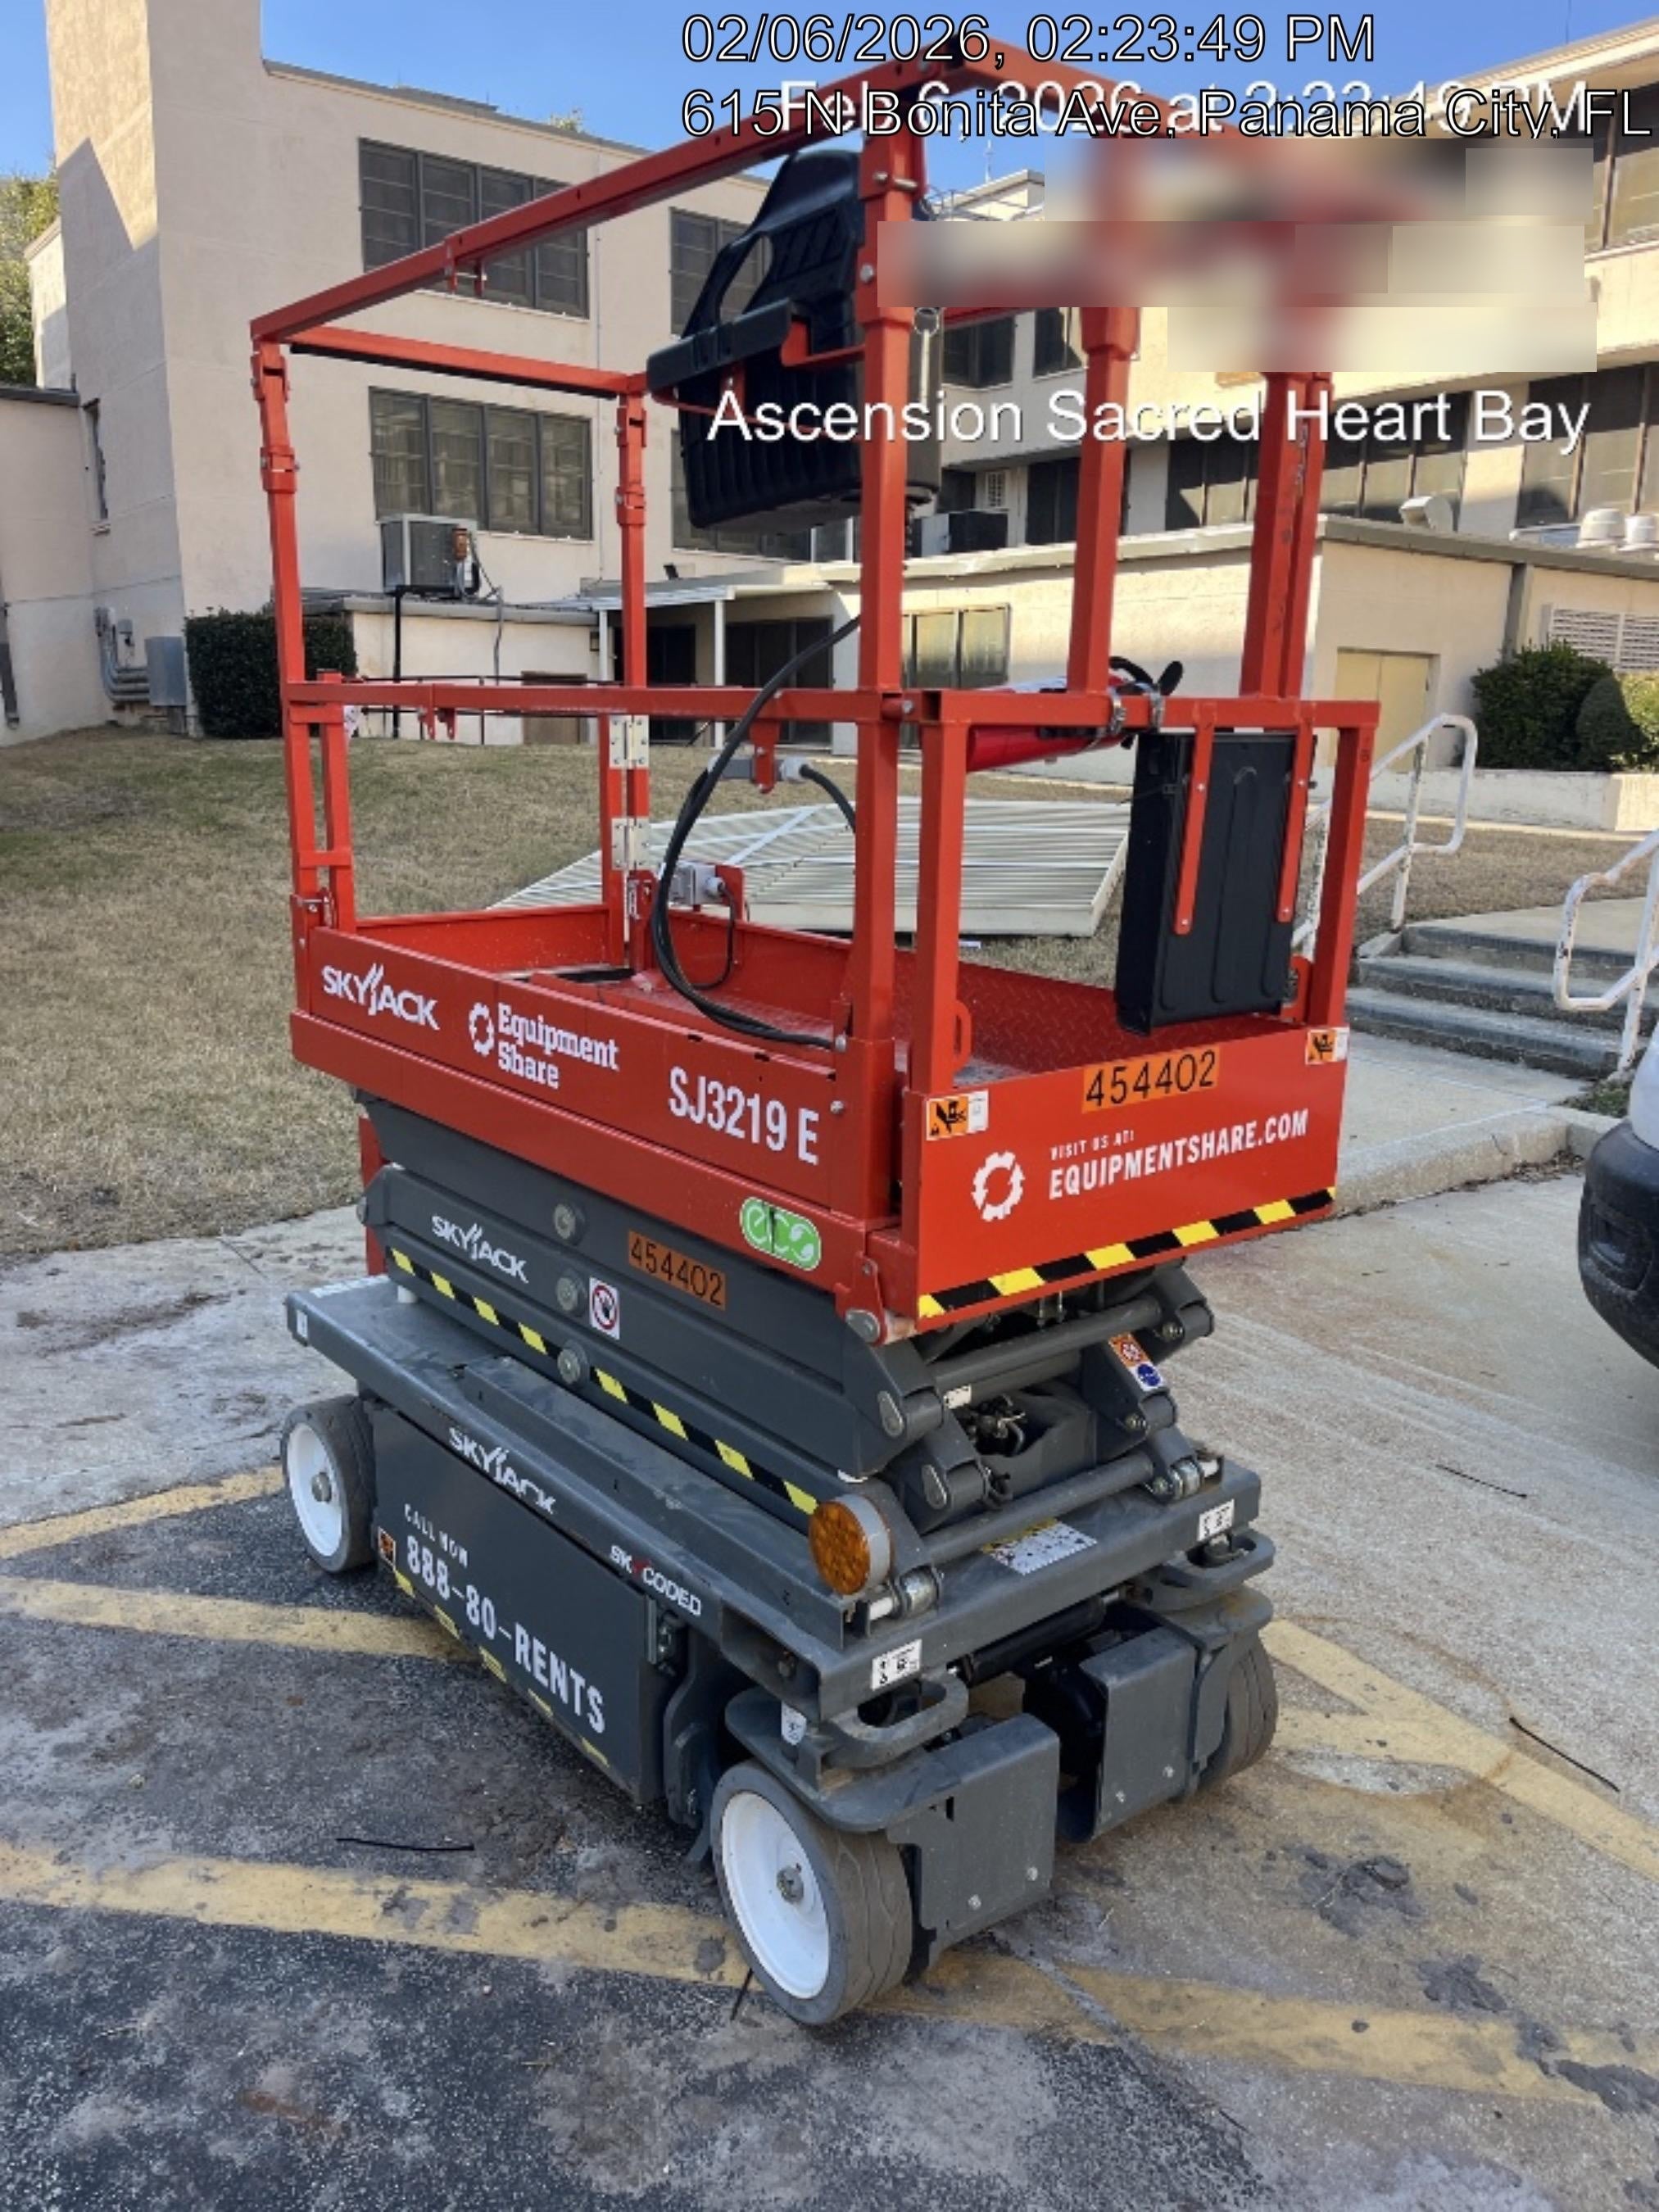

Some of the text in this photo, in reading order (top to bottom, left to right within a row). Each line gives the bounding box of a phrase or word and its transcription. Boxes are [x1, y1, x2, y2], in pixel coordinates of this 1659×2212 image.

[321, 963, 440, 1031] SKYJACK
[497, 1002, 620, 1072] Equipment
[497, 1040, 560, 1090] Share
[1086, 1049, 1216, 1106] 454402
[669, 1066, 819, 1166] SJ3219 E
[1049, 1108, 1309, 1200] EQUIPMENTSHARE.COM
[630, 1236, 724, 1308] 454402
[407, 1534, 605, 1734] 888-80-RENTS
